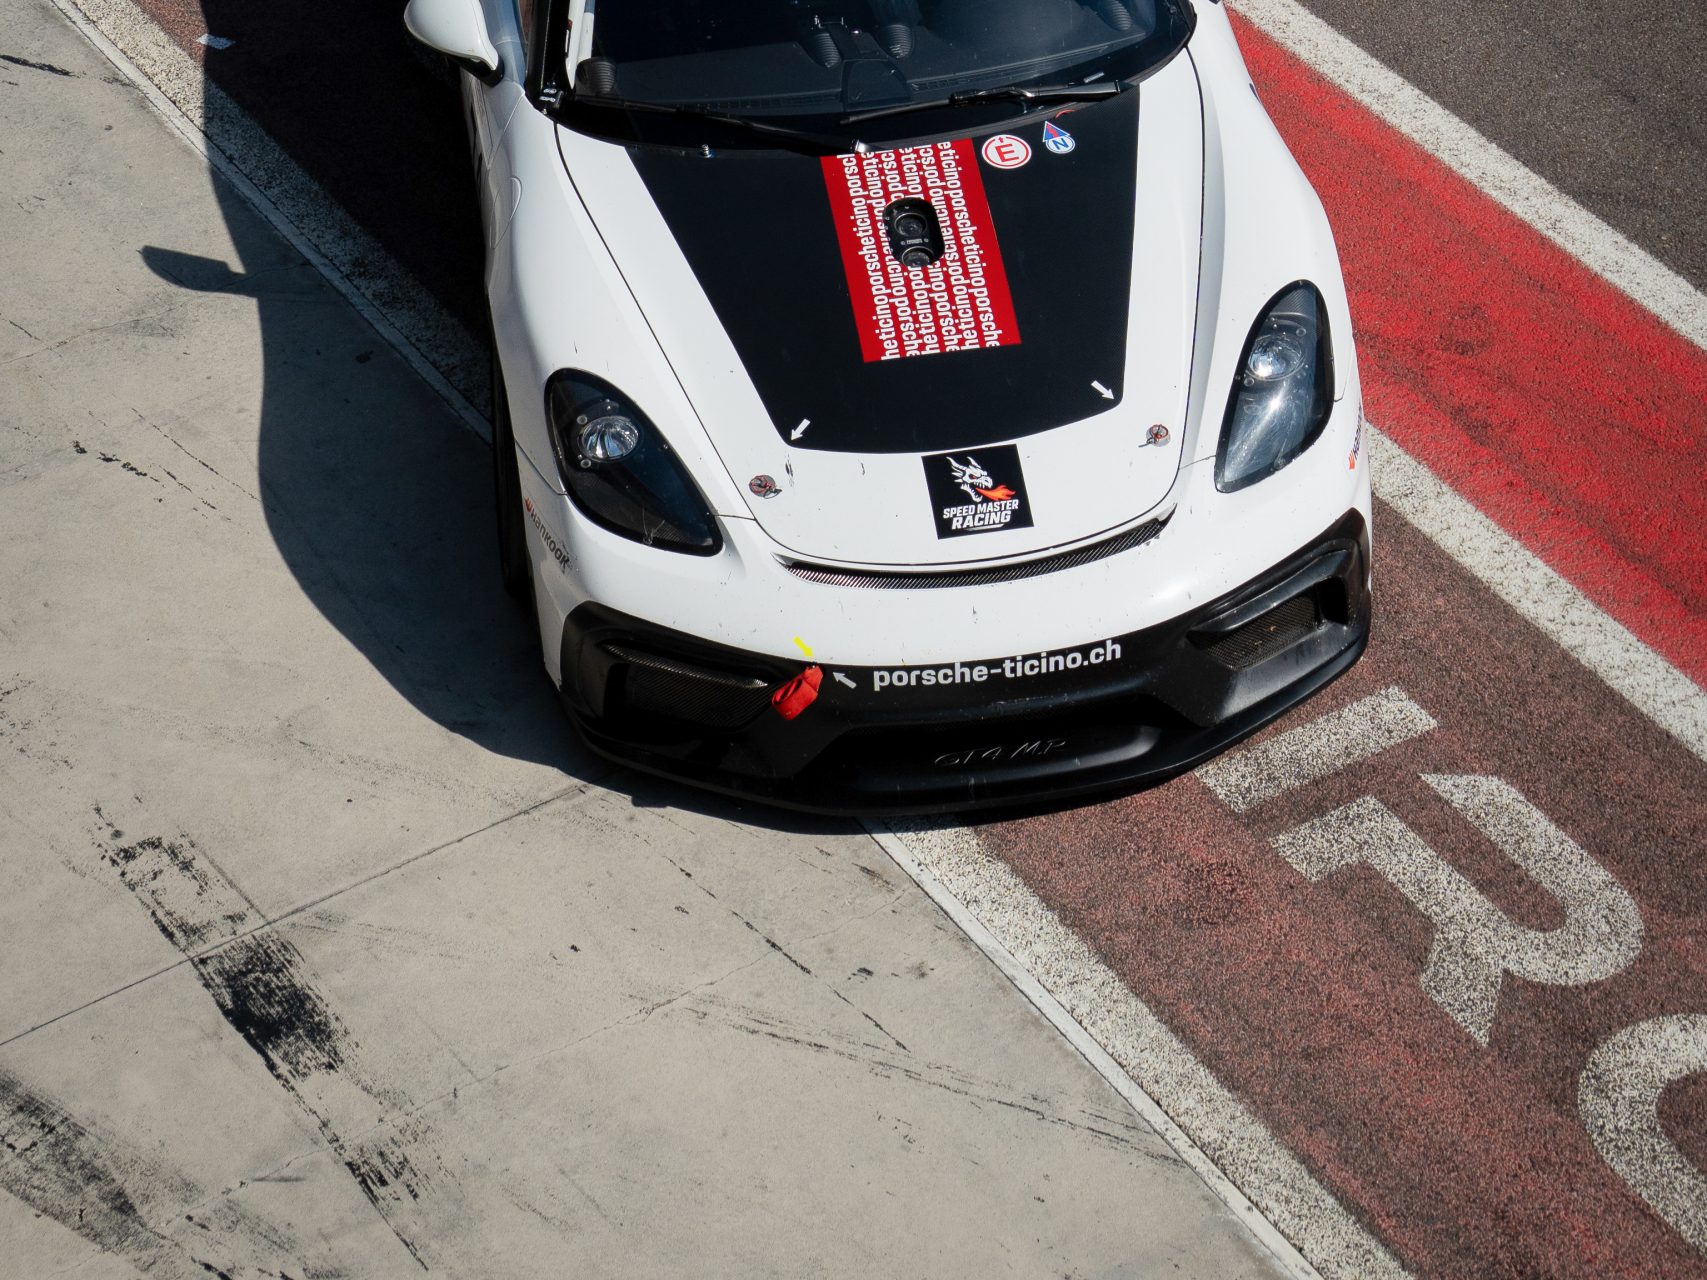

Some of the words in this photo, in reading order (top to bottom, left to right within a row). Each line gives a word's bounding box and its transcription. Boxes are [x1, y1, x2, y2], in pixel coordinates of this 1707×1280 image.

[994, 143, 1020, 163] E
[1052, 137, 1069, 150] N
[943, 504, 975, 519] SPEED
[977, 499, 1019, 514] MASTER
[951, 510, 1012, 530] RACING
[873, 640, 1122, 691] porsche-ticino.ch
